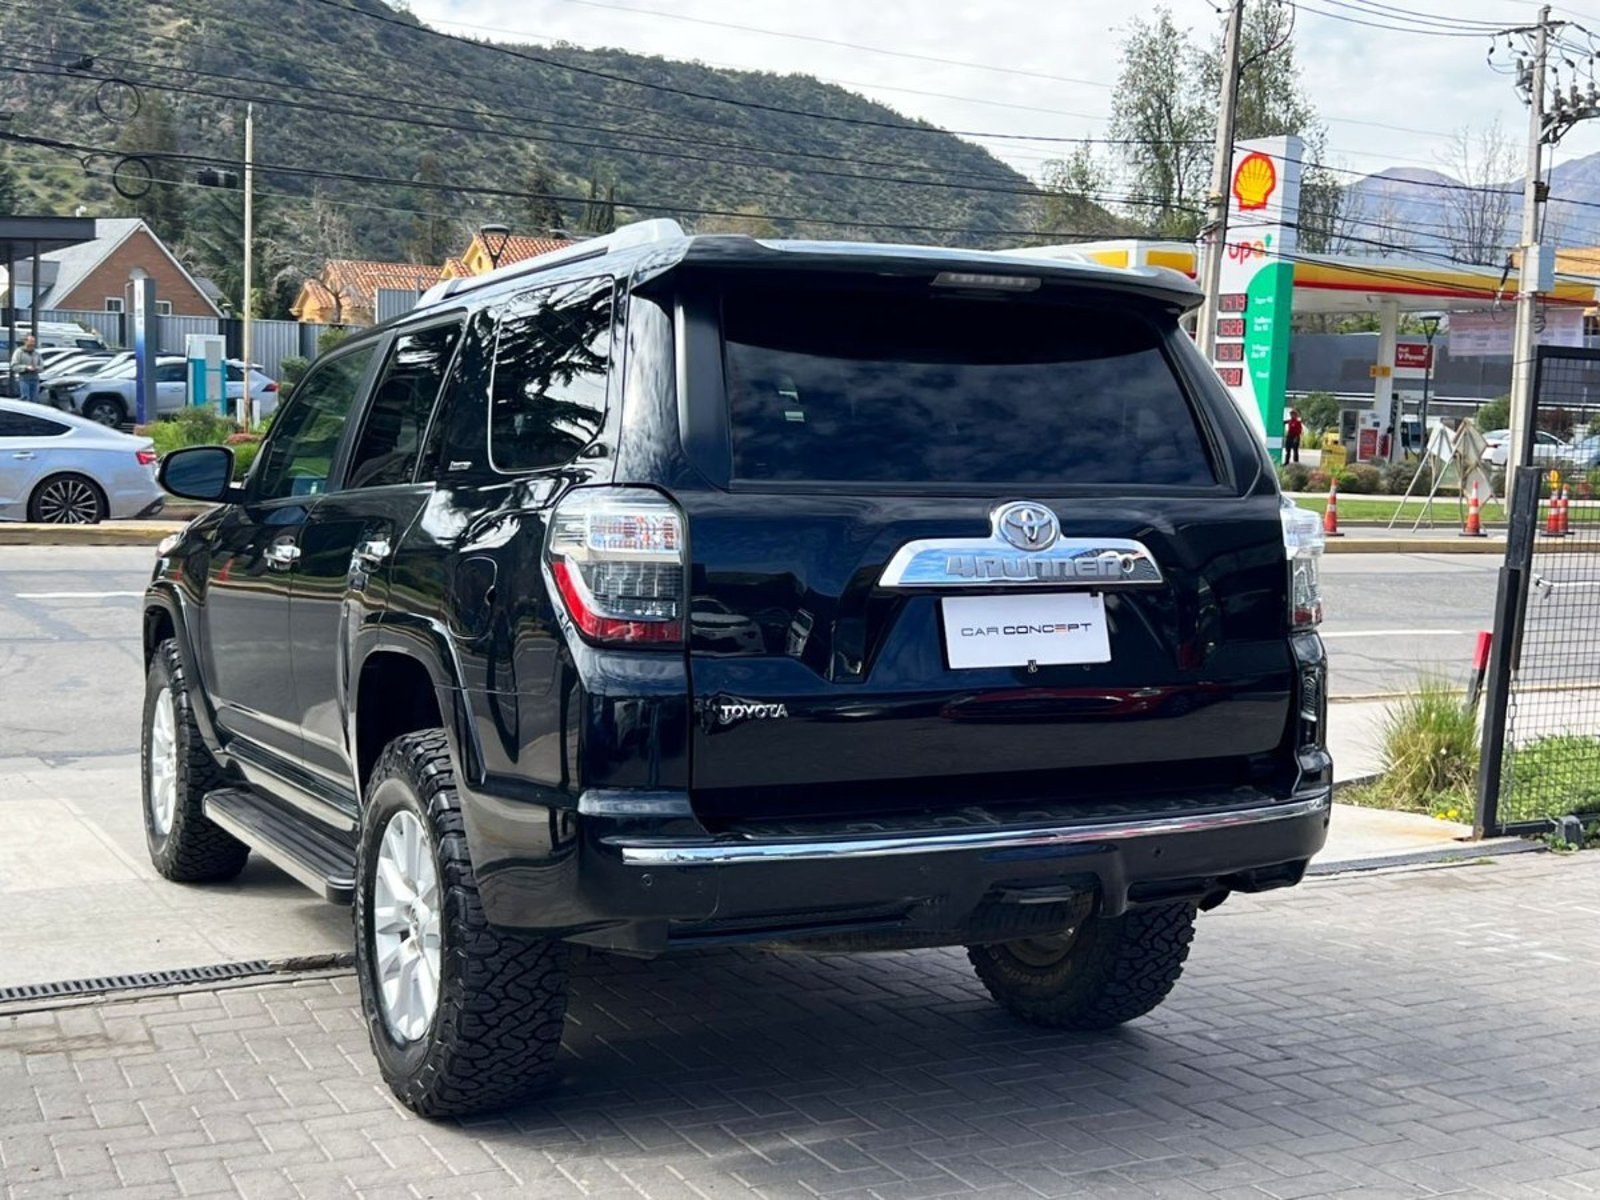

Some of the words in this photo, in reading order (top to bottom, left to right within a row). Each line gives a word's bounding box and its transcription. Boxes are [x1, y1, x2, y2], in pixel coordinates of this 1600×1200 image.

[961, 627, 998, 637] CAR
[1003, 623, 1092, 634] CONCEPT
[721, 704, 788, 719] TOYOTA
